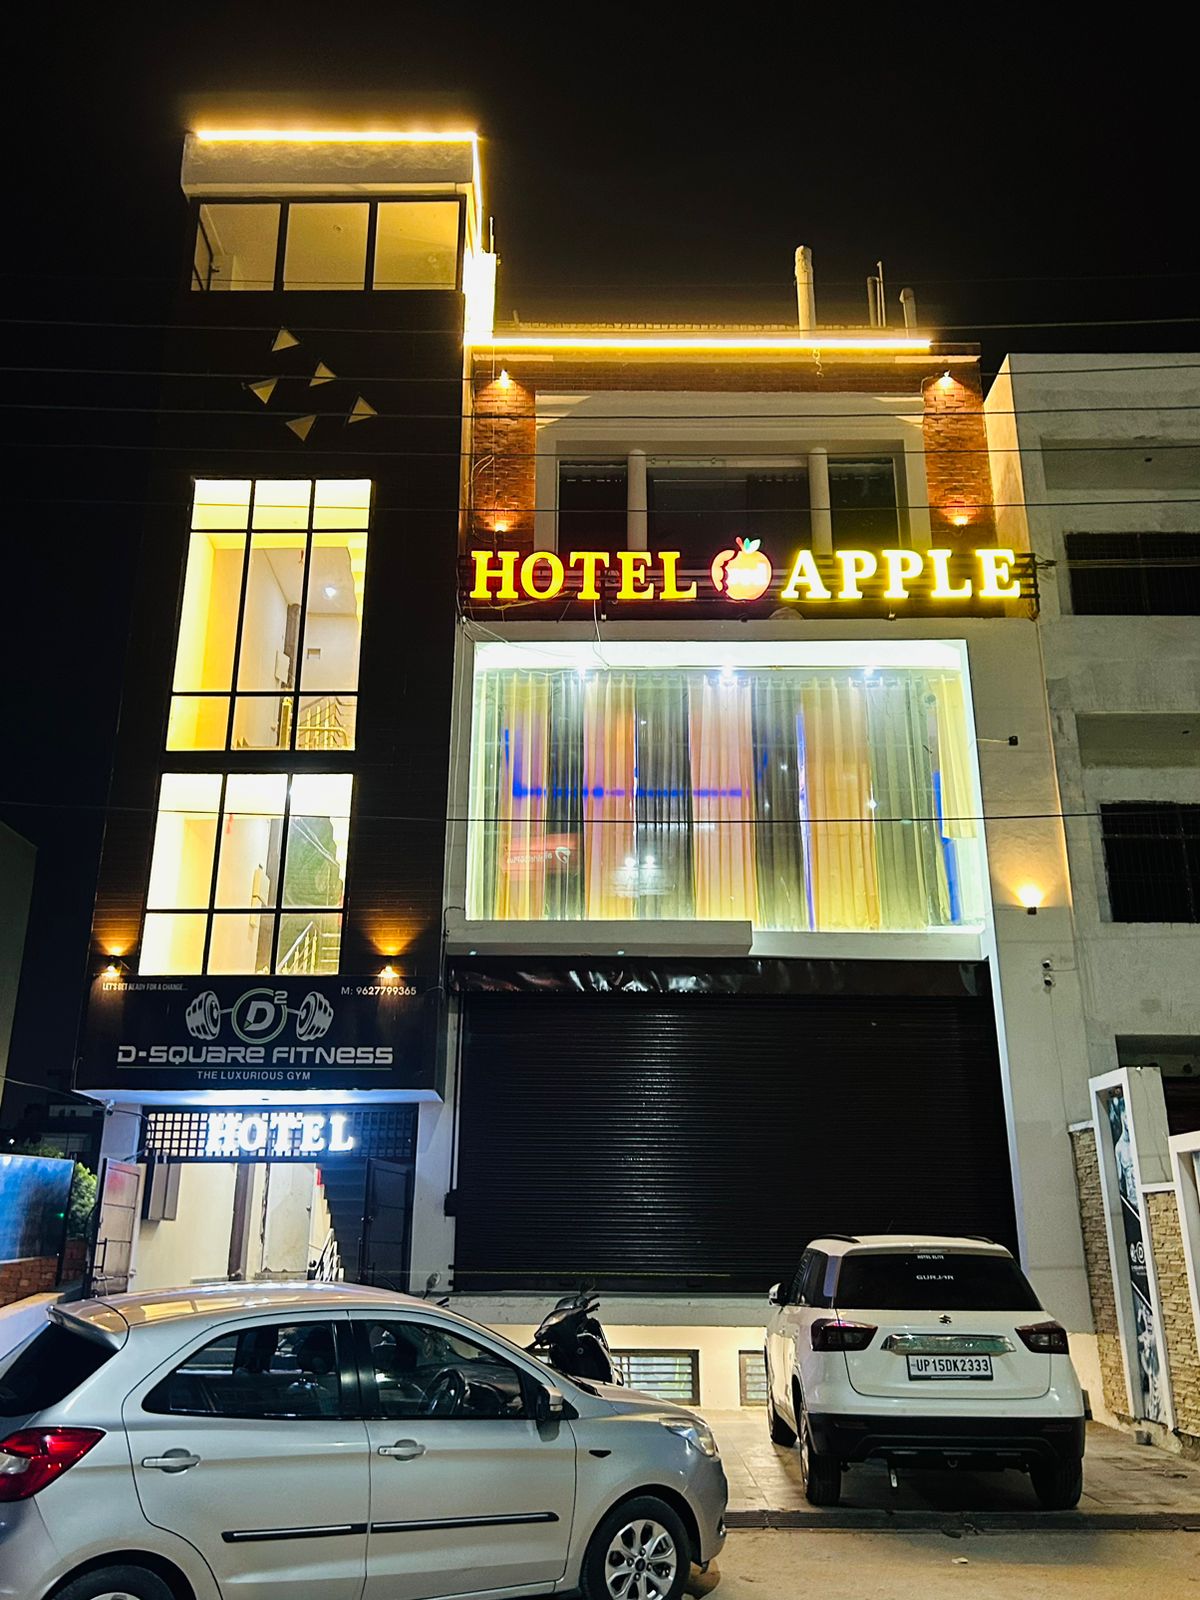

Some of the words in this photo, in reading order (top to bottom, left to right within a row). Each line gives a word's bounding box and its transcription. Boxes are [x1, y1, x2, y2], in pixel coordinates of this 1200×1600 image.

[469, 550, 698, 601] HOTEL
[780, 548, 1022, 601] APPLE
[340, 986, 354, 996] M:
[356, 986, 417, 996] 9627799365
[117, 1045, 265, 1065] D-SQUARE
[197, 1070, 218, 1080] THE
[220, 1070, 284, 1081] LUXURIOUS
[287, 1071, 312, 1081] GYM
[205, 1112, 354, 1152] HOTEL
[916, 1358, 989, 1372] UP15DK2333
